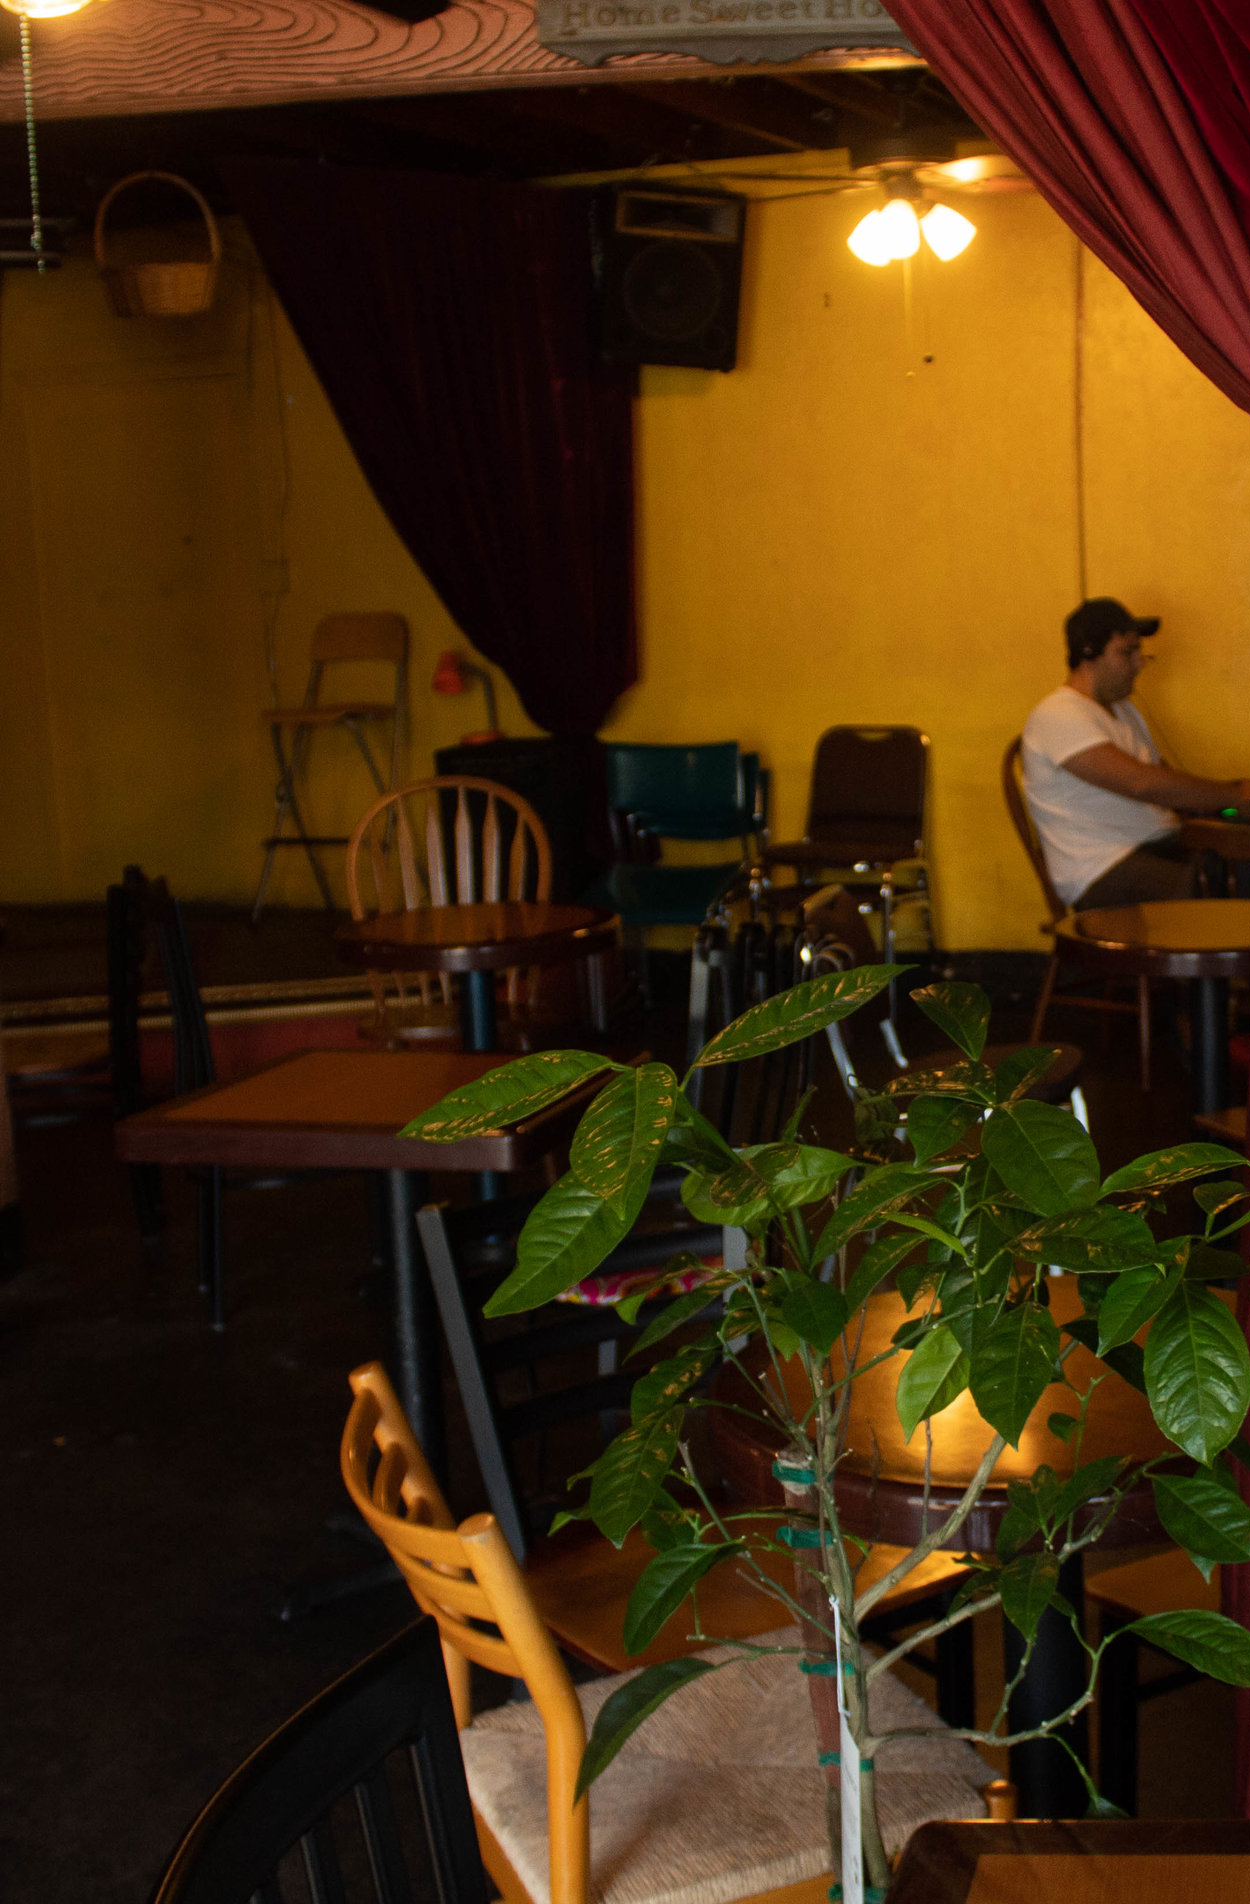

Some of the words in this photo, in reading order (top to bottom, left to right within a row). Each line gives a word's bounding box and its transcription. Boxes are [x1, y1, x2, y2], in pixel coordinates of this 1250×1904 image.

[561, 0, 681, 29] Home
[689, 0, 814, 24] Sweet
[825, 0, 892, 20] Ho
